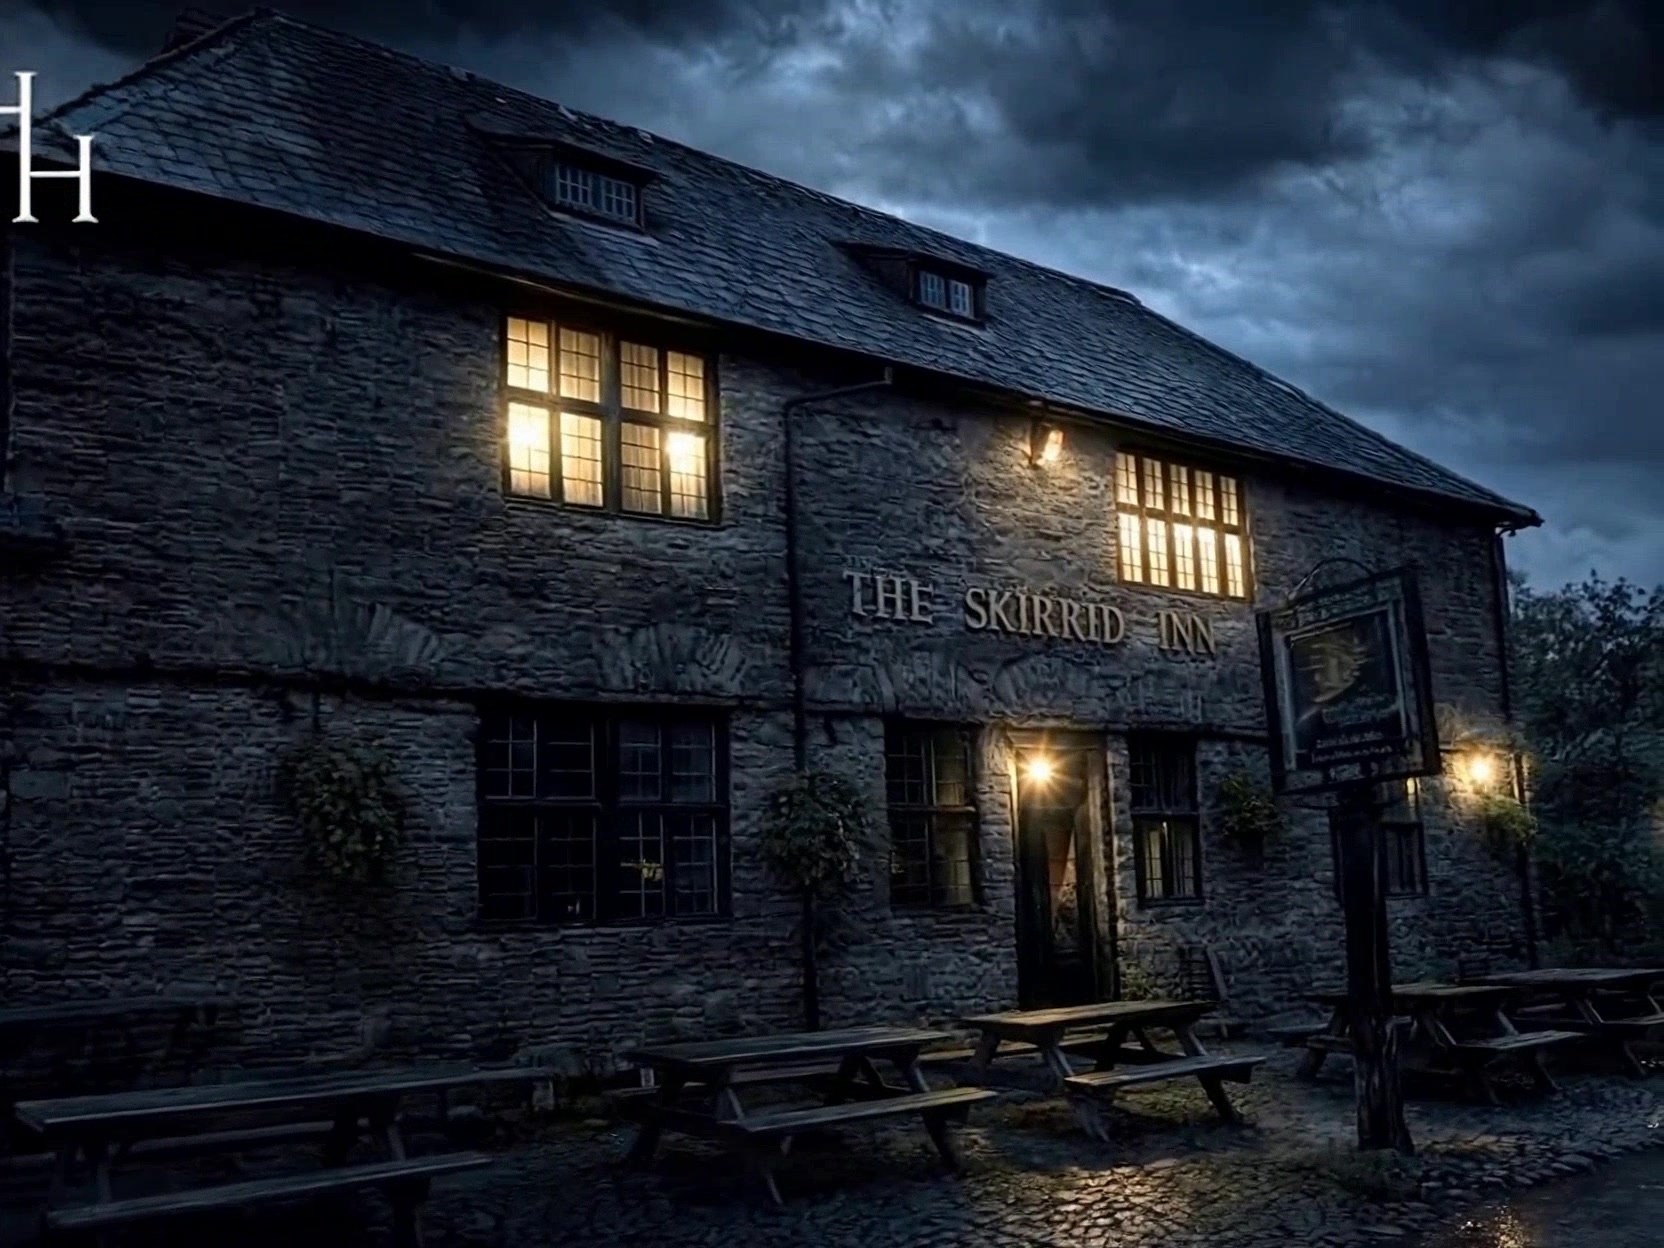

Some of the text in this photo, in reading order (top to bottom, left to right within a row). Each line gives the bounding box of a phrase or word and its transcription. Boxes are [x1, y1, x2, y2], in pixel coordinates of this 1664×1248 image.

[844, 571, 1216, 655] THE SKIRRID INN
